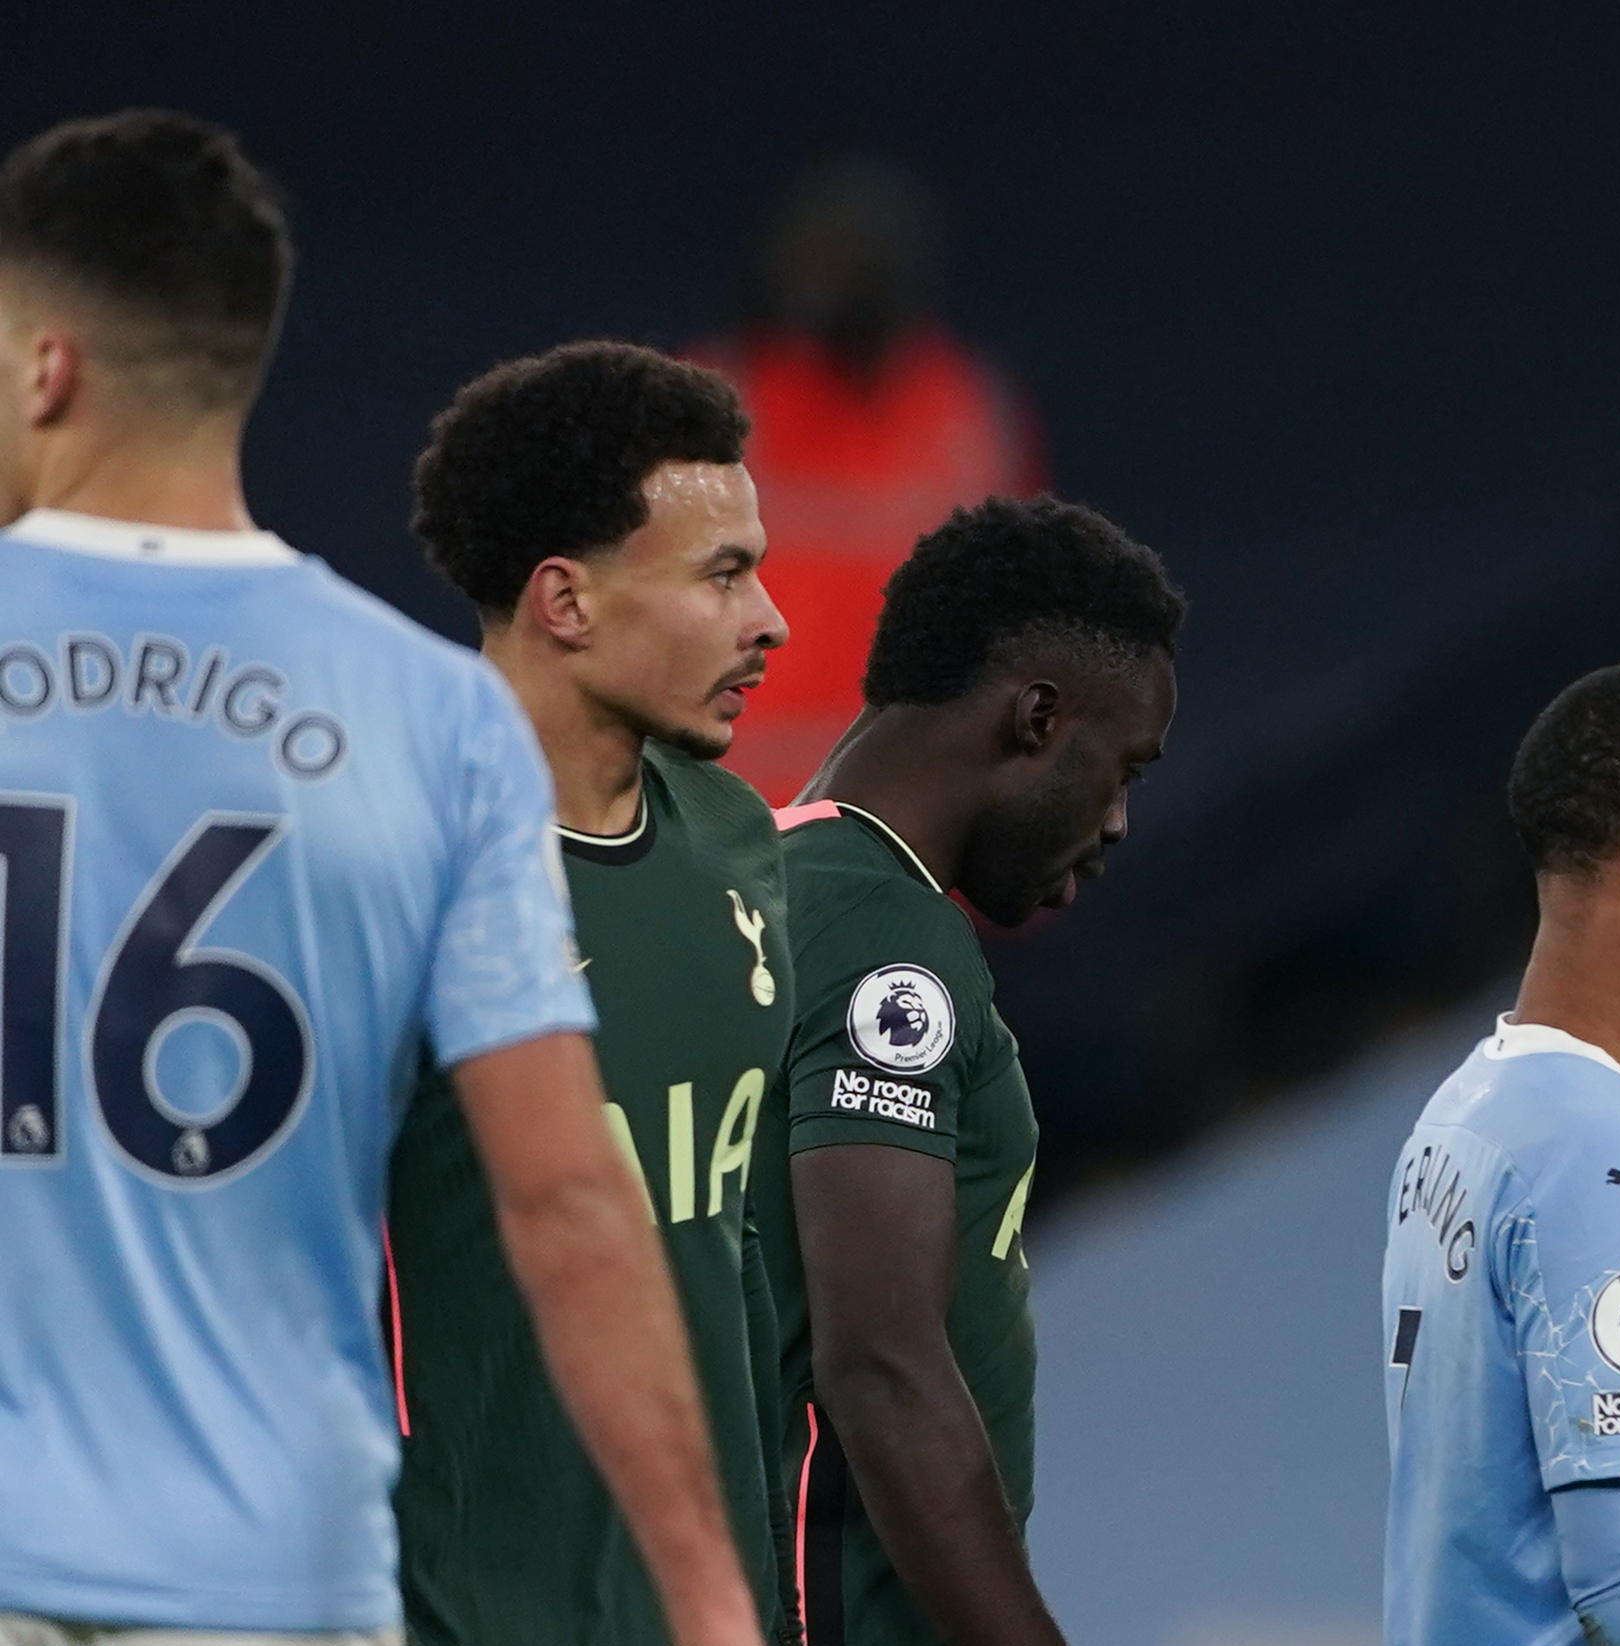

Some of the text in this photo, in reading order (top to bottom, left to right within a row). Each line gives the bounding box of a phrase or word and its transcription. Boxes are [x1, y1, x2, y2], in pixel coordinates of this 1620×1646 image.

[0, 632, 350, 783] ODRIGO
[0, 790, 316, 1192] 16
[895, 1020, 944, 1063] Premier League
[831, 1087, 936, 1129] for racism
[834, 1069, 932, 1108] No room
[1399, 1144, 1475, 1282] ERLING
